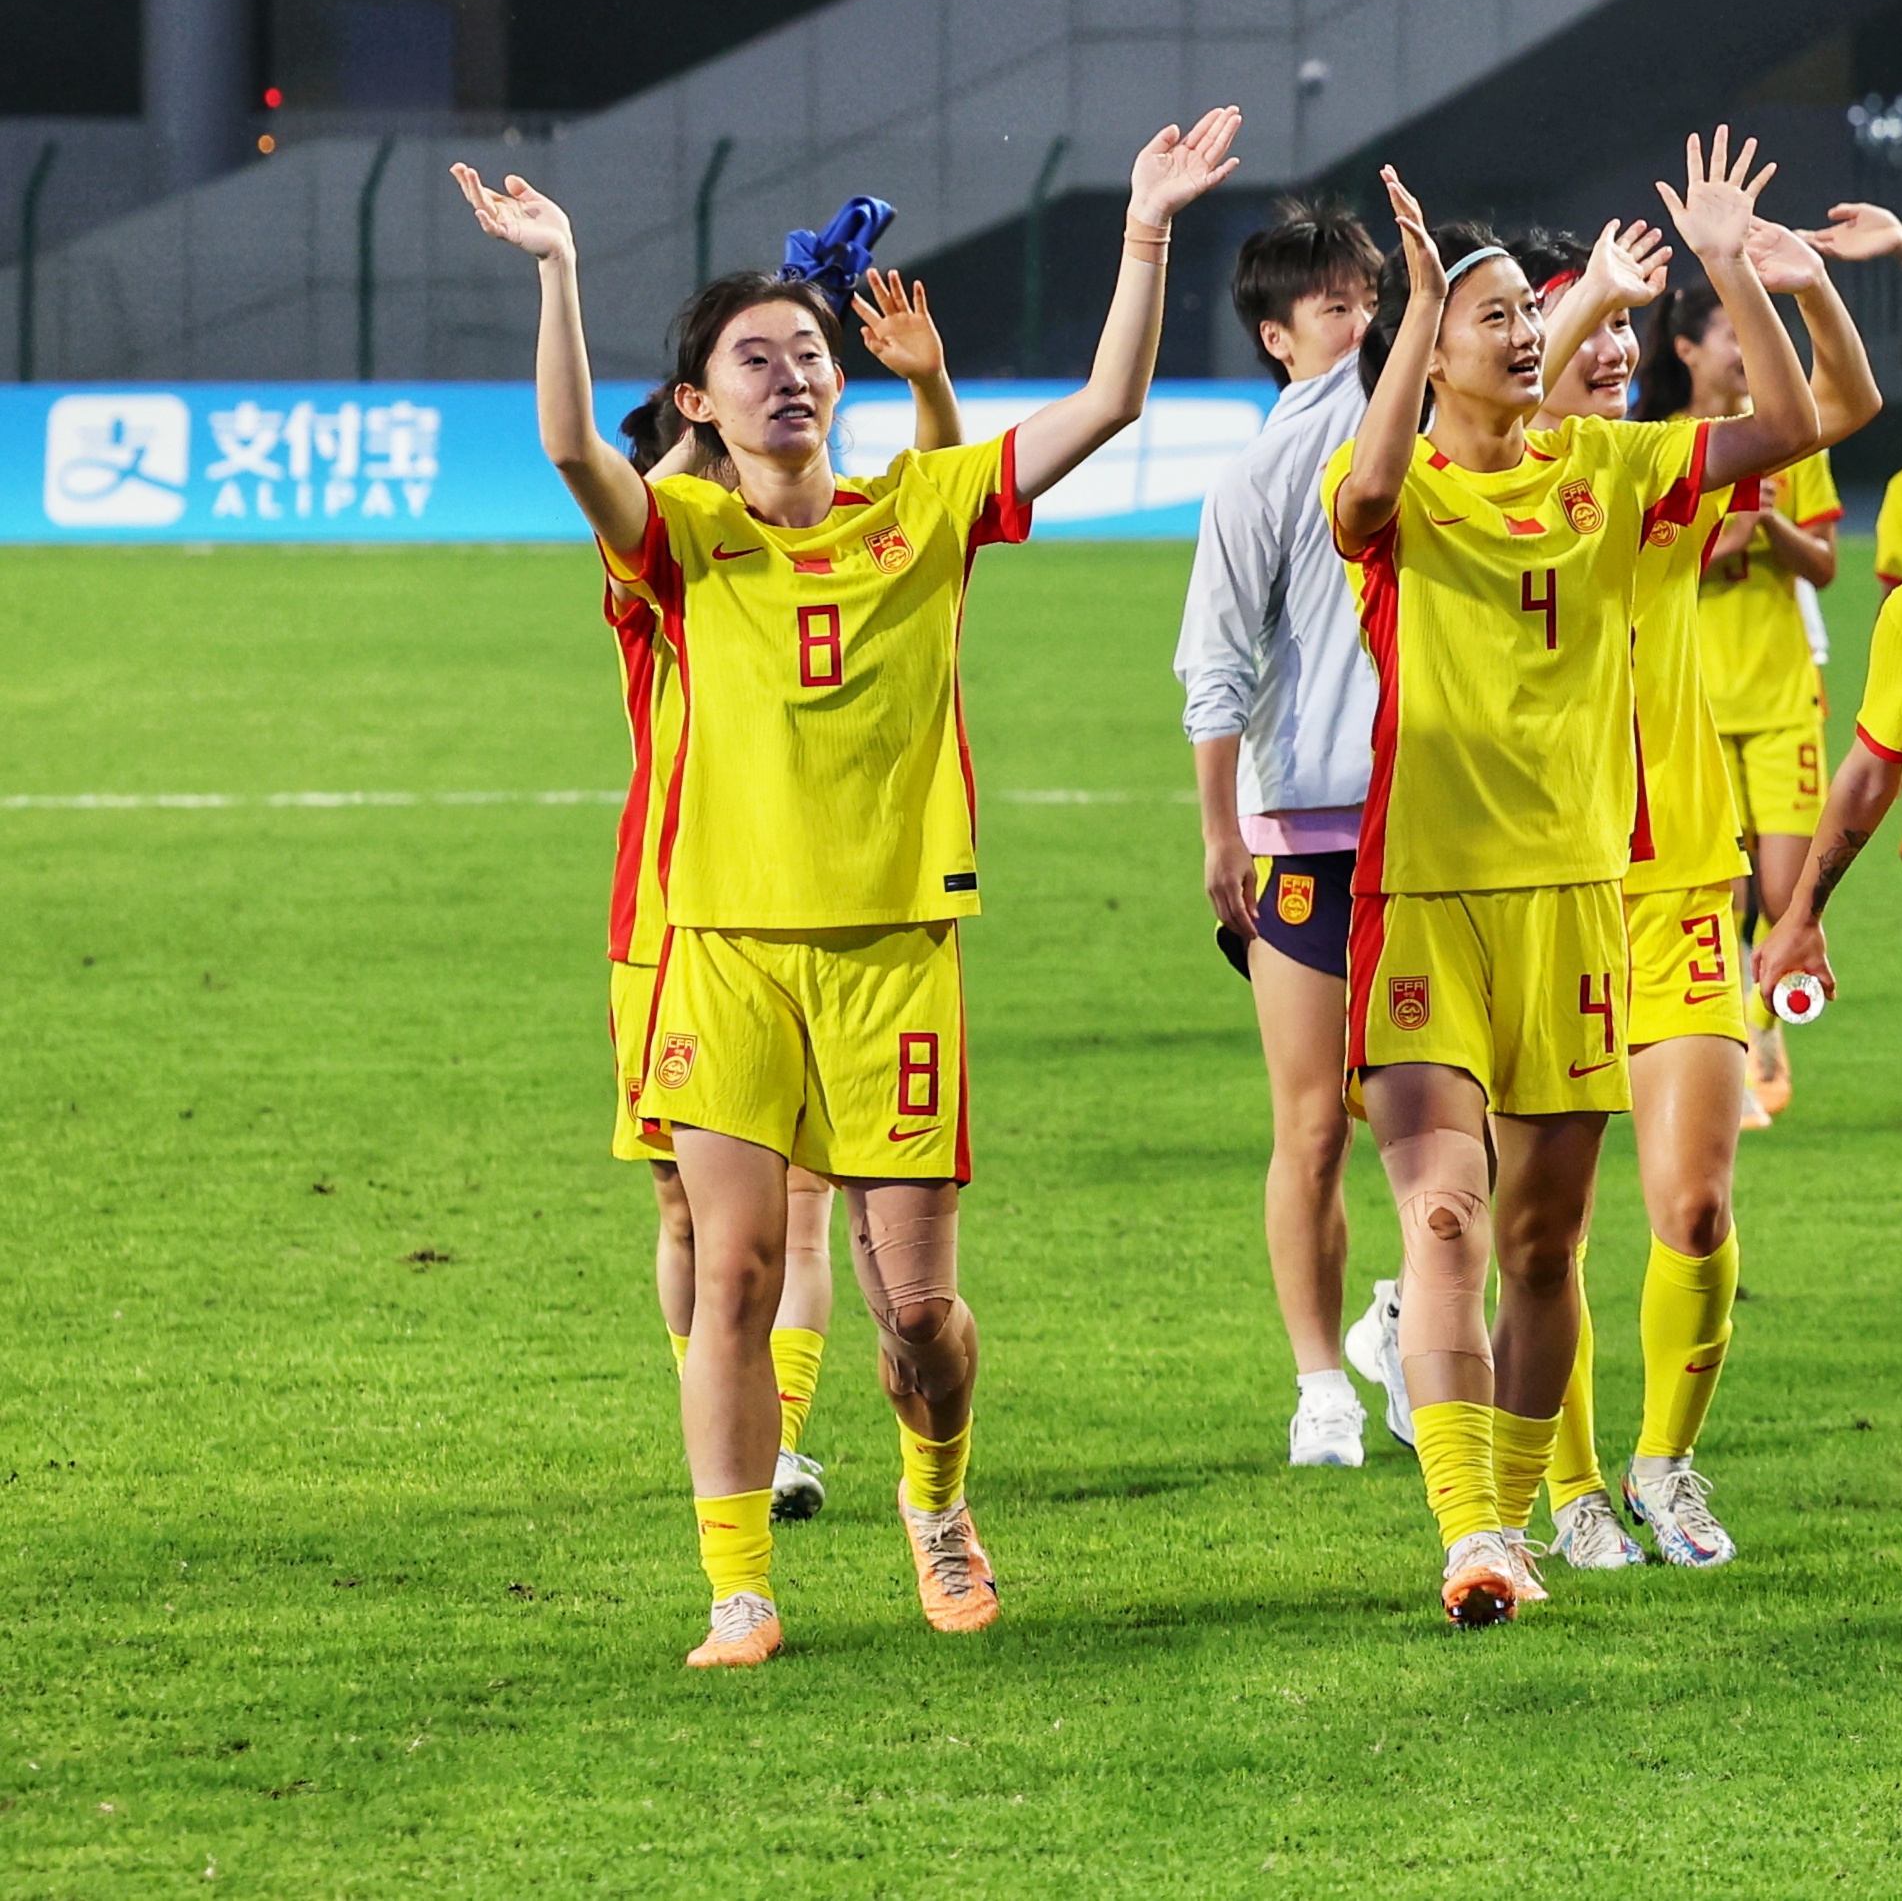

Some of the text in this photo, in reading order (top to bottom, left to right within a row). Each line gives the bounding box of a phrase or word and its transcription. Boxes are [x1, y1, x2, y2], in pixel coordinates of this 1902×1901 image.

[205, 399, 442, 482] 支付宝
[212, 480, 433, 519] ALIPAY
[797, 603, 843, 688] 8
[1520, 568, 1557, 651] 4
[1682, 912, 1726, 983] 3
[1579, 972, 1615, 1055] 4
[899, 1032, 940, 1116] 8
